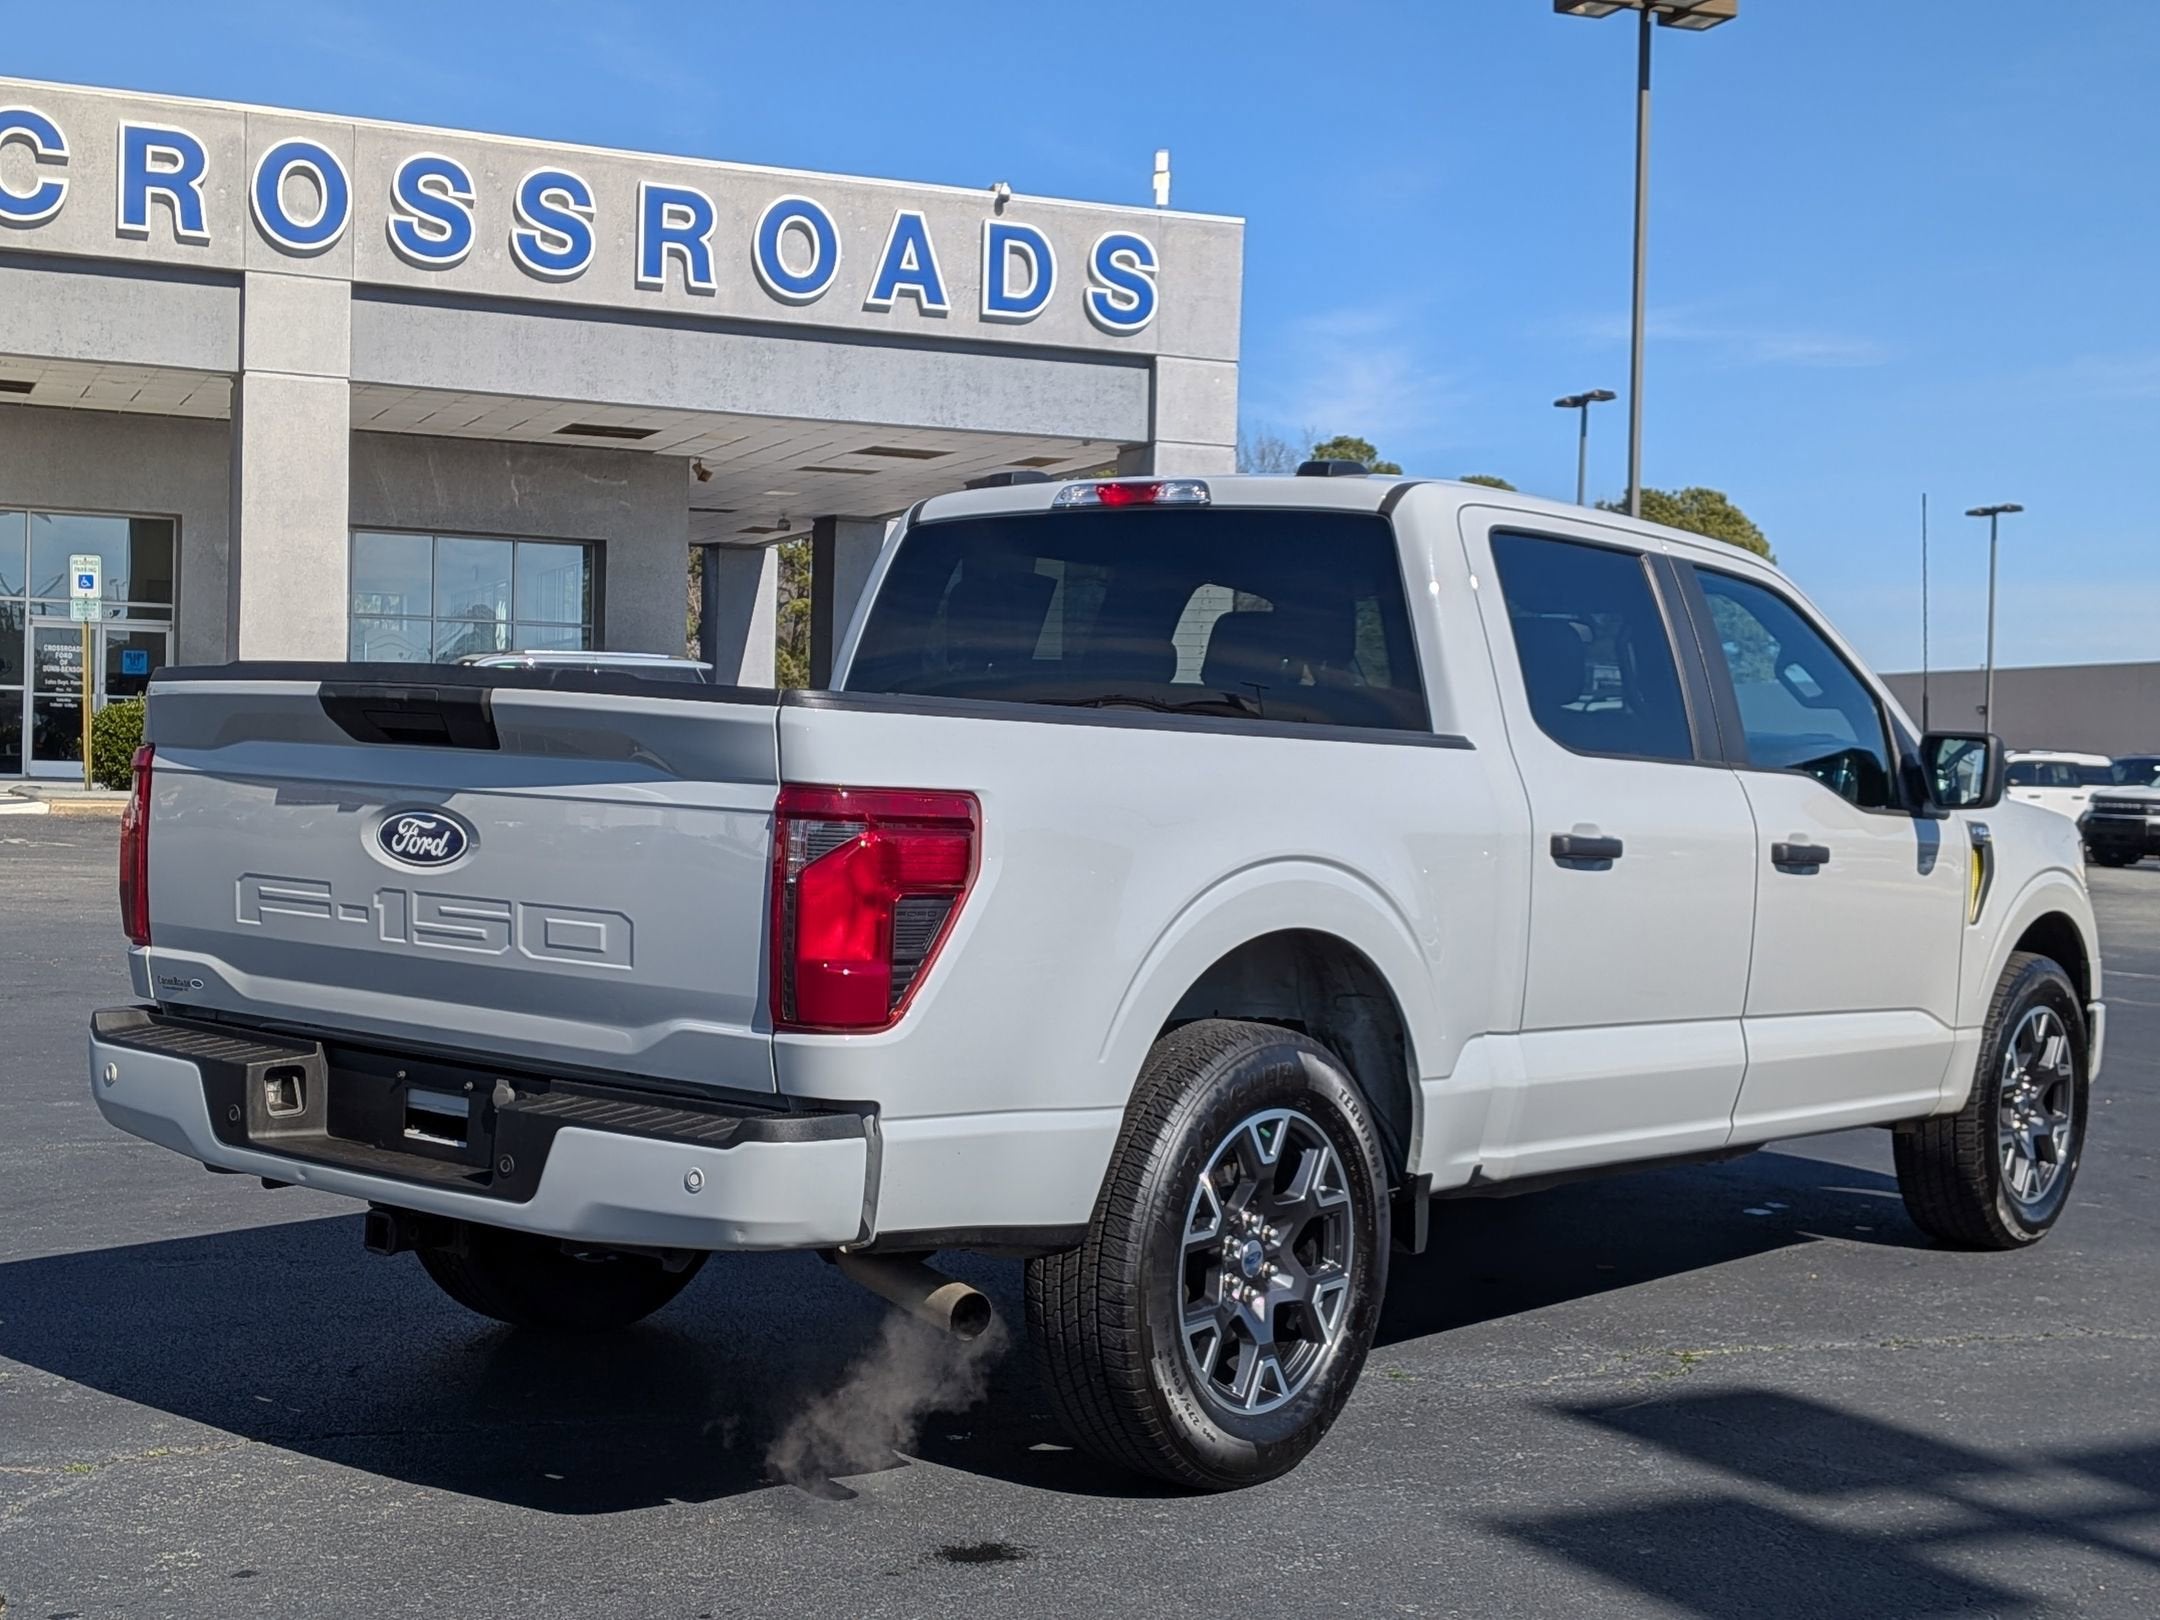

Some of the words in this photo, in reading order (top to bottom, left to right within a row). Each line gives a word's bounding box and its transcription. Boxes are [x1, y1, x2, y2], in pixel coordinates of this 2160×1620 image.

[0, 105, 1160, 332] CROSSROADS
[55, 652, 73, 660] FORD
[391, 817, 451, 857] Ford
[235, 872, 634, 970] F-150
[1338, 1088, 1383, 1179] TERRITORY
